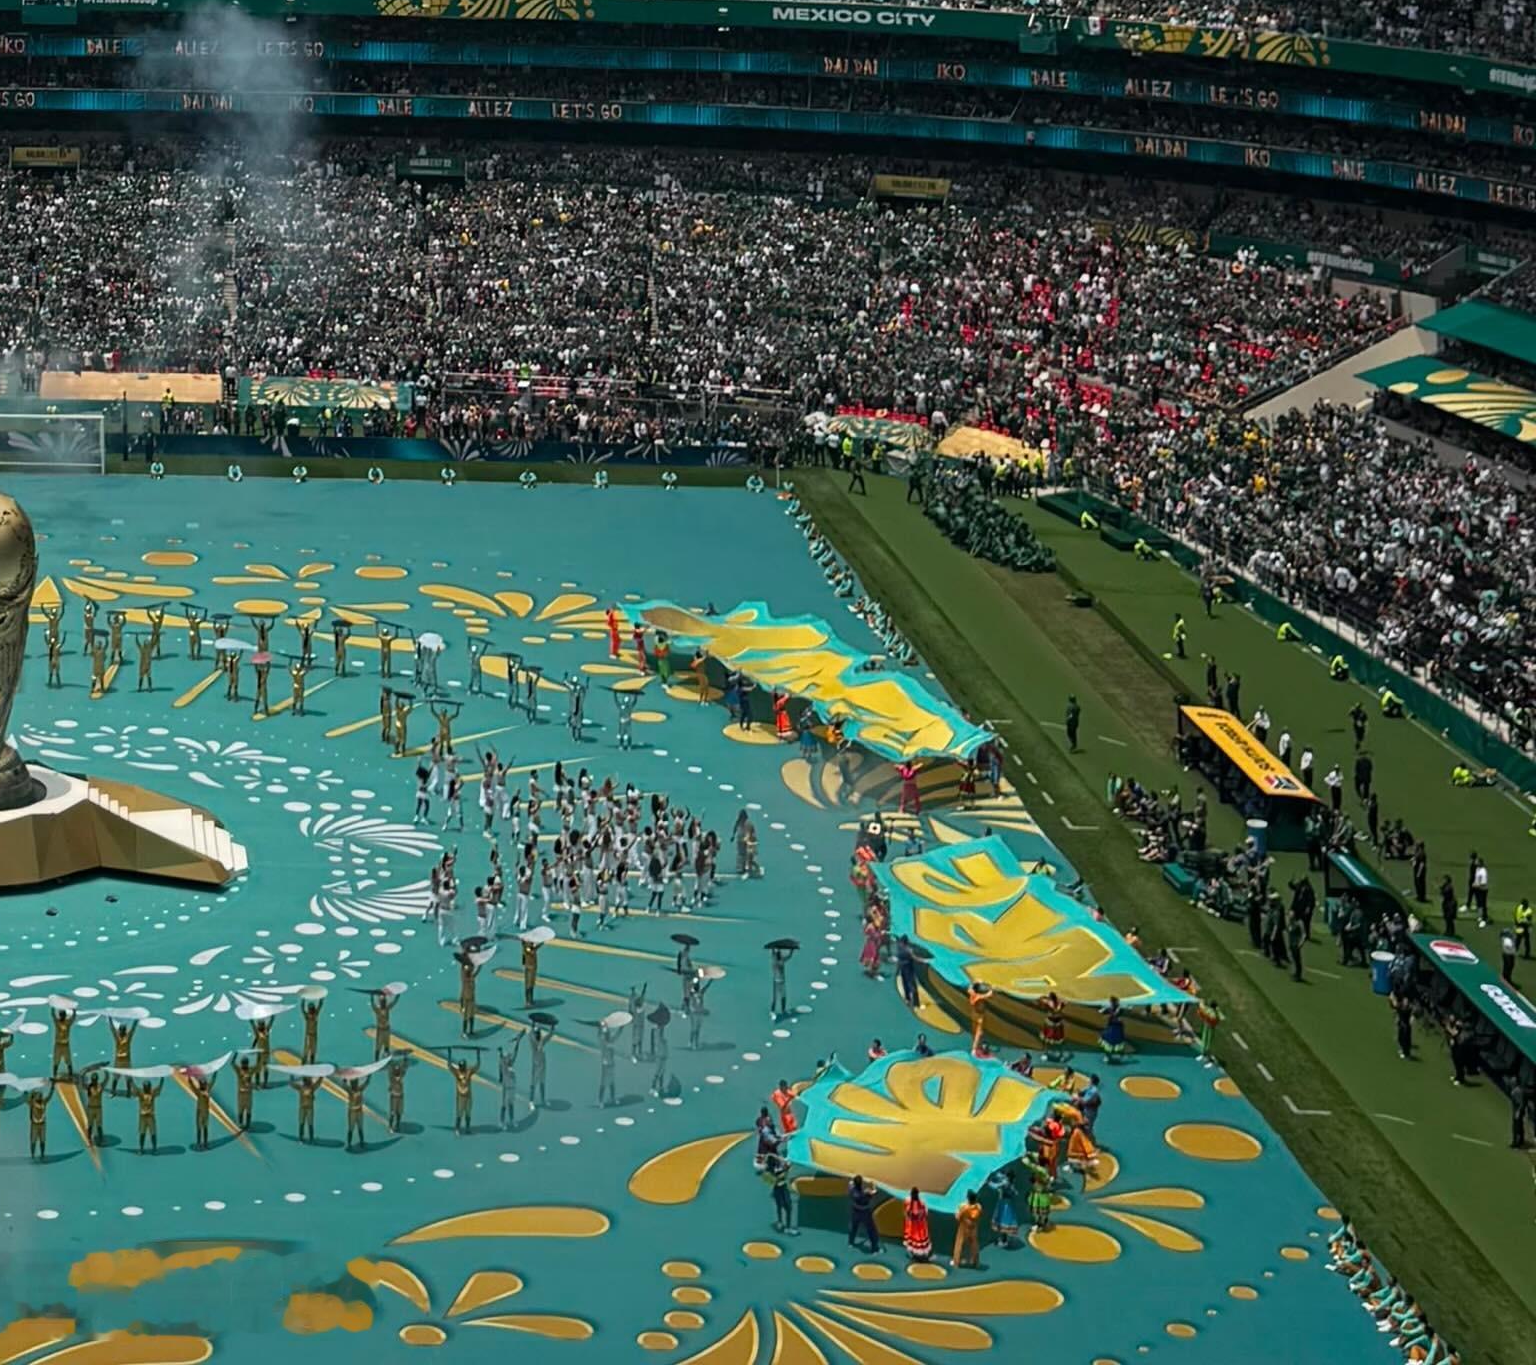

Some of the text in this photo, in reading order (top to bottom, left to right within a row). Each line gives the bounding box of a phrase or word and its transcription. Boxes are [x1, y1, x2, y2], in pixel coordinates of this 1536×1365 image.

[772, 7, 935, 27] MEXICO CITY
[87, 38, 122, 54] DALE
[937, 63, 965, 81] IKO
[1031, 69, 1068, 87] DALE
[1125, 78, 1172, 98] ALLEZ
[1257, 90, 1279, 108] GO
[15, 92, 35, 107] GO
[377, 98, 412, 115] DALE
[469, 101, 512, 117] ALLEZ
[552, 102, 594, 118] LET'S
[600, 104, 622, 119] GO
[1245, 148, 1270, 167] IKO
[1416, 172, 1456, 196] ALLEZ
